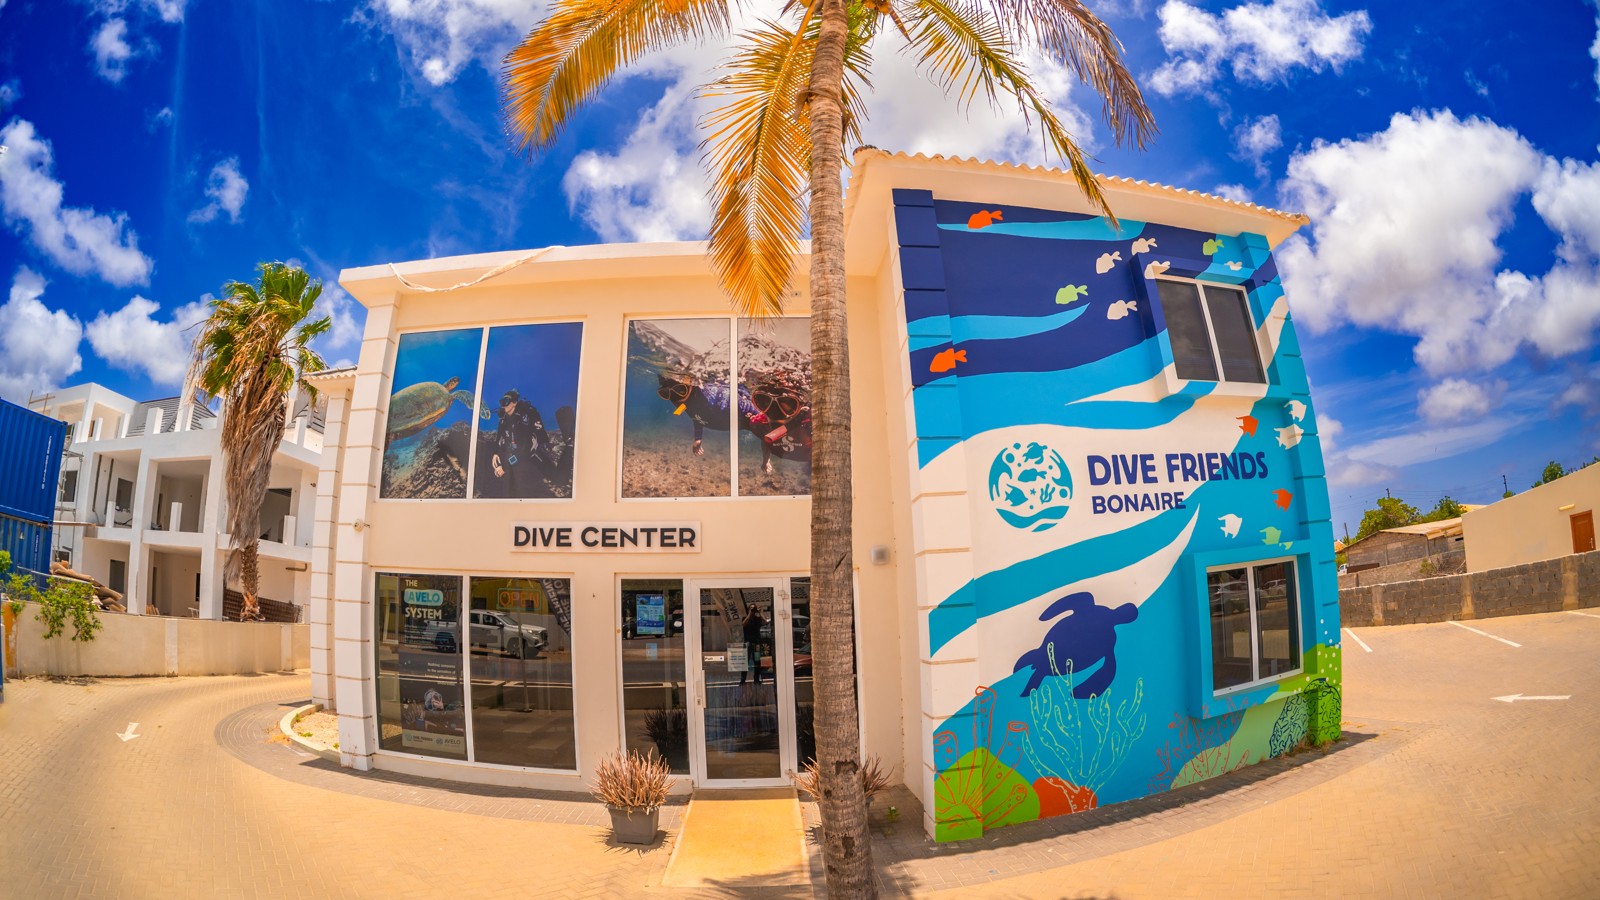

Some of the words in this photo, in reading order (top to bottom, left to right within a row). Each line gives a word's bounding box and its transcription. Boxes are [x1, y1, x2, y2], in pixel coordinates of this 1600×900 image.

[1086, 454, 1158, 486] DIVE
[1165, 451, 1269, 483] FRIENDS
[1091, 491, 1186, 515] BONAIRE
[514, 526, 572, 547] DIVE
[581, 526, 696, 547] CENTER
[408, 591, 441, 604] AVELO
[499, 591, 540, 609] OPEN
[404, 607, 442, 620] SYSTEM
